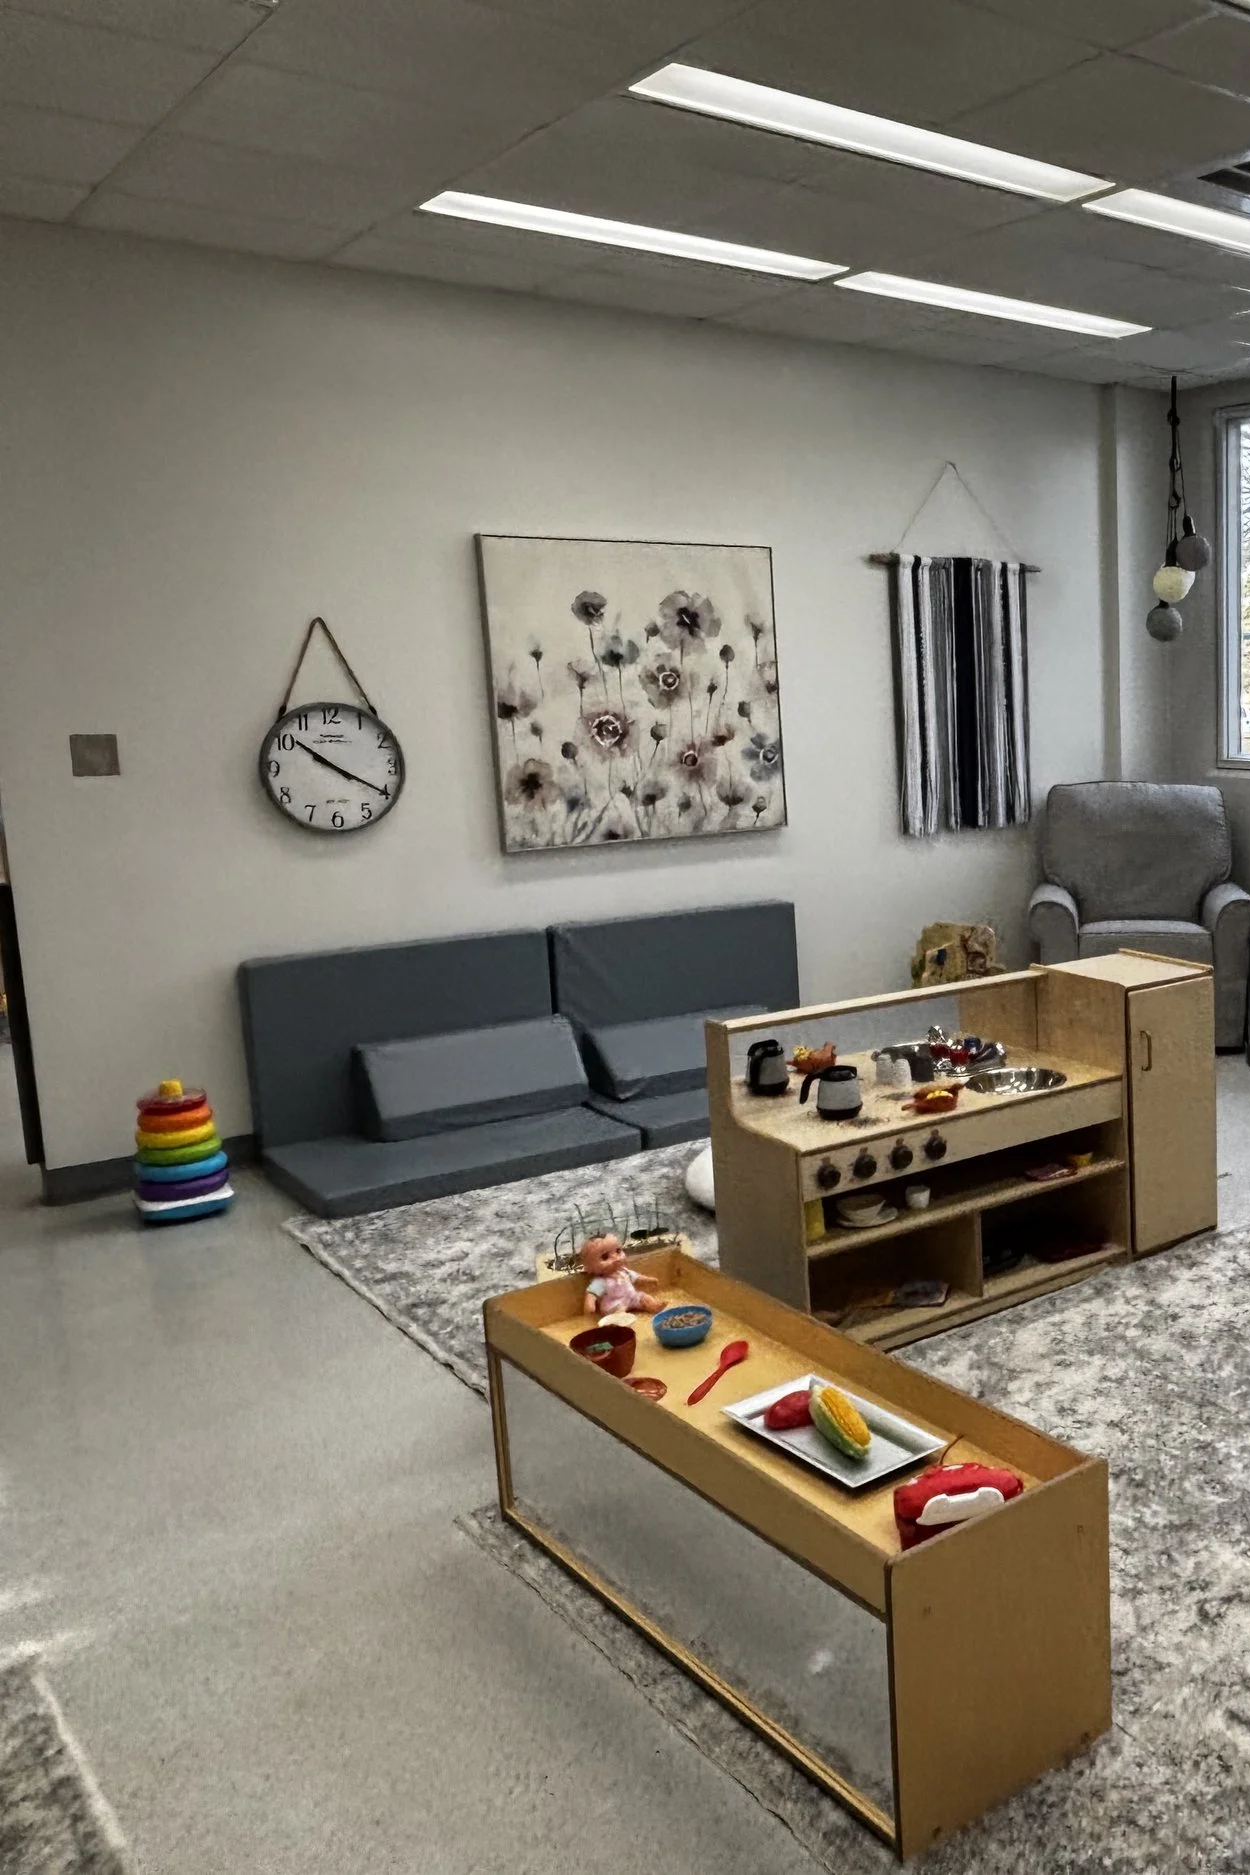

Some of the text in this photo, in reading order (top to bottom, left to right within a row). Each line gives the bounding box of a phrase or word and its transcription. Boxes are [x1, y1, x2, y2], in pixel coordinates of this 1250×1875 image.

[298, 713, 308, 731] 11
[321, 707, 342, 725] 12
[357, 712, 362, 731] 1
[276, 733, 295, 751] 10
[377, 731, 392, 750] 2
[268, 760, 280, 778] 9
[387, 757, 397, 776] 3
[280, 786, 292, 804] 8
[304, 804, 317, 822] 7
[331, 810, 345, 828] 6
[360, 802, 373, 821] 5
